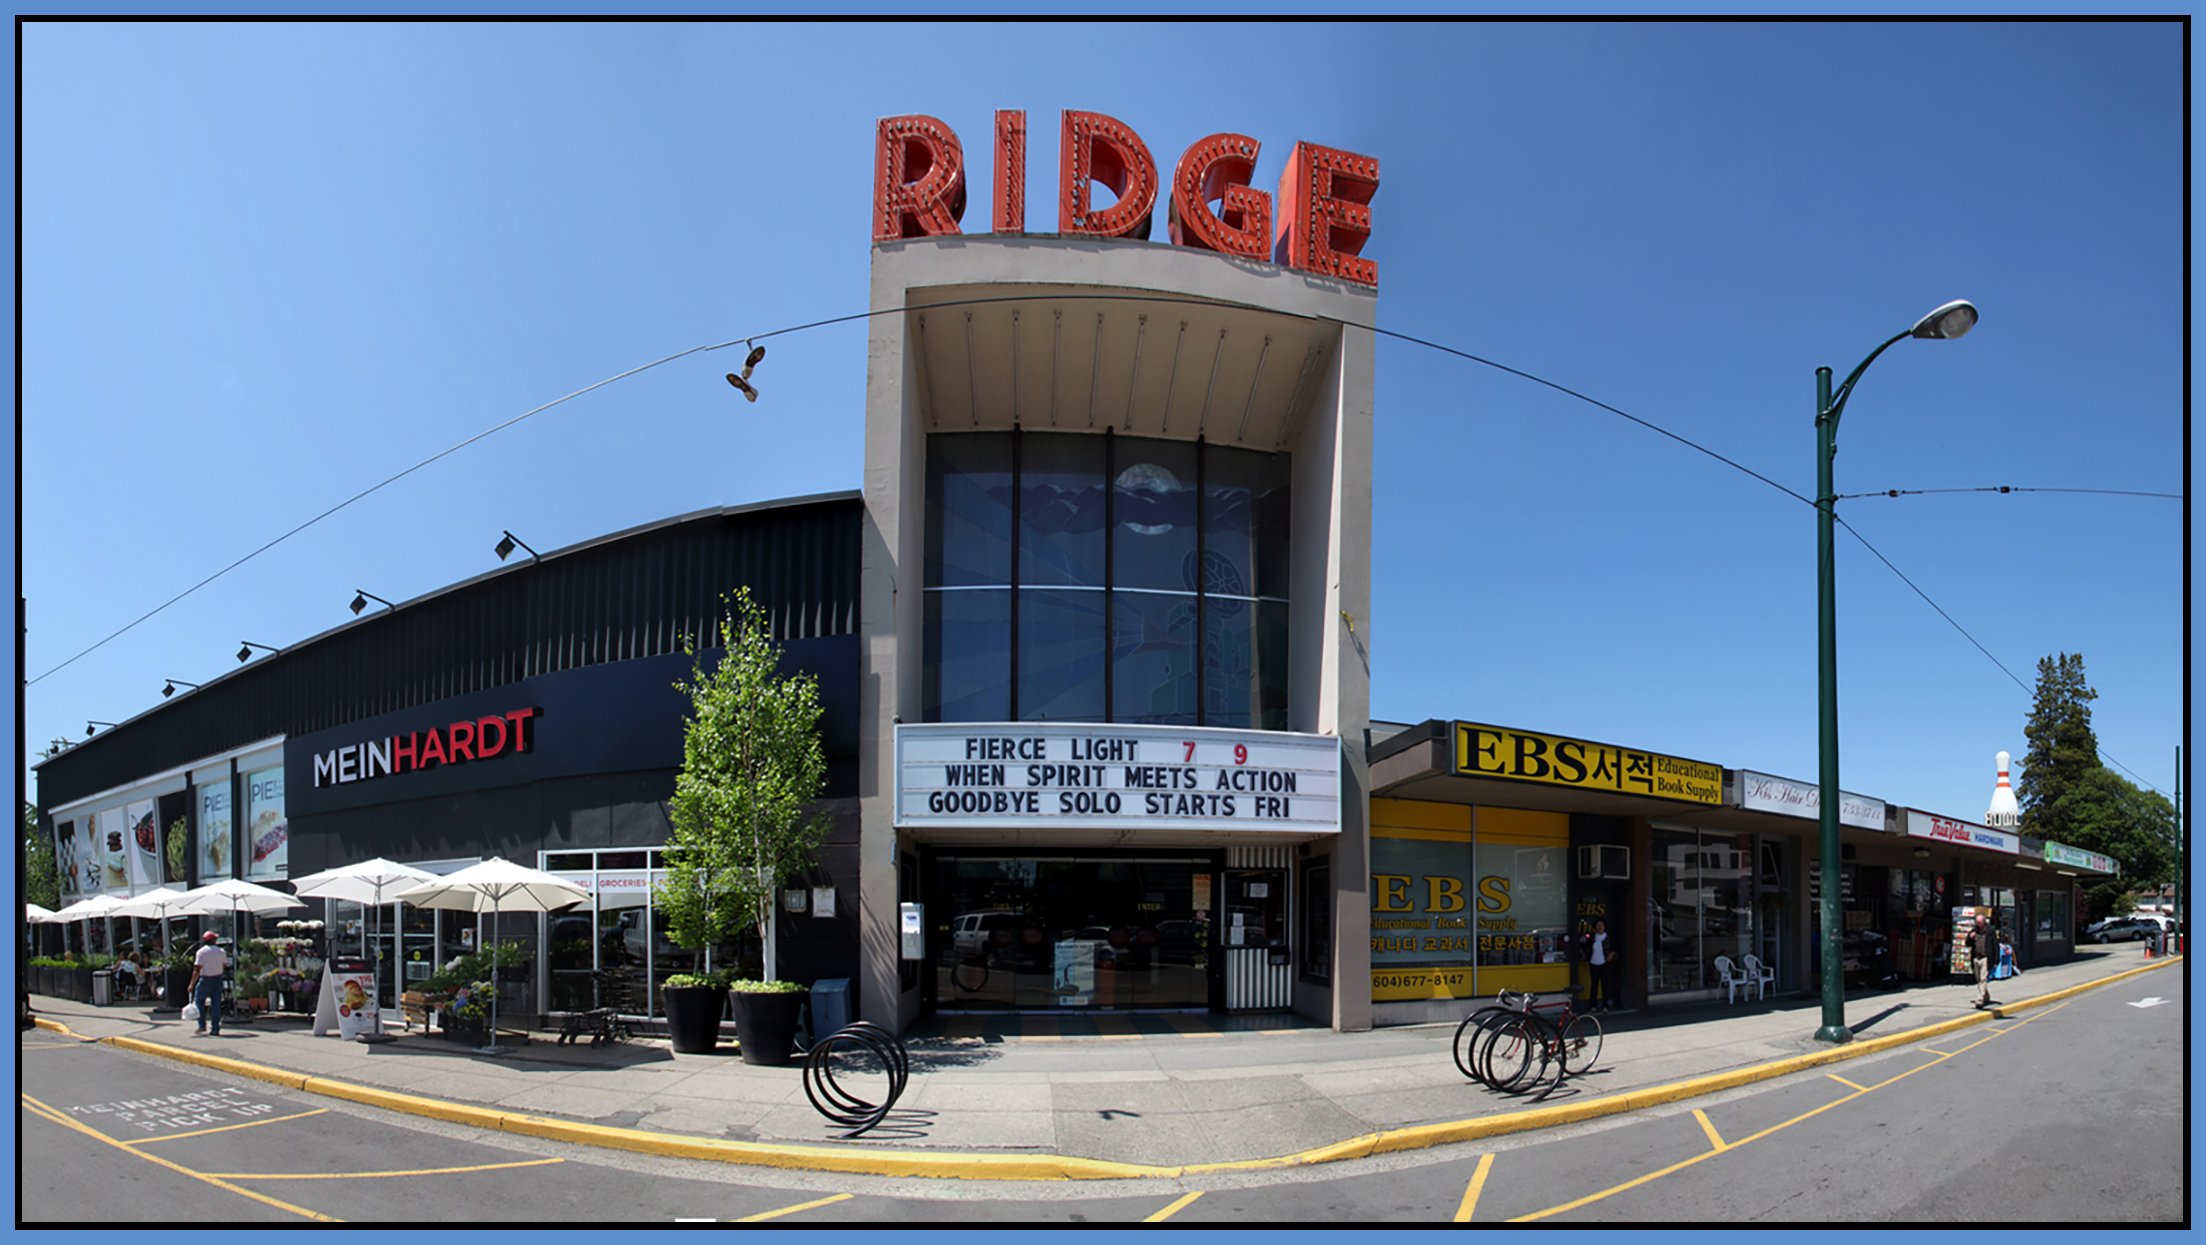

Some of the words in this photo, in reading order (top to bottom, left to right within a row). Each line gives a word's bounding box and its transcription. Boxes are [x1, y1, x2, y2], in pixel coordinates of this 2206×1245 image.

[872, 109, 1379, 286] RIDGE
[313, 707, 538, 788] MEINHARDT
[965, 738, 1046, 760] FIERCE
[1071, 738, 1138, 762] LIGHT
[1182, 741, 1196, 763] 7
[1233, 743, 1248, 765] 9
[945, 765, 1005, 787] WHEN
[1027, 765, 1106, 787] SPIRIT
[1124, 766, 1197, 790] MEETS
[1215, 769, 1297, 793] ACTION
[1657, 757, 1720, 782] Educational
[1657, 776, 1684, 795] Book
[1685, 784, 1720, 802] Supply
[1774, 782, 1803, 805] Hair
[928, 791, 1040, 814] GOODBYE
[1059, 791, 1122, 814] SOLO
[1145, 793, 1236, 816] STARTS
[1254, 796, 1291, 818] FRI
[1984, 811, 2021, 827] BOWL
[1974, 832, 2004, 848] HARDWARE
[599, 878, 647, 888] GROCERIES
[1371, 874, 1513, 914] EBS
[1436, 917, 1468, 930] Book
[1478, 917, 1519, 933] Supply
[115, 1098, 250, 1122] PARCEL
[135, 1111, 227, 1132] PICK
[231, 1103, 273, 1117] UP
